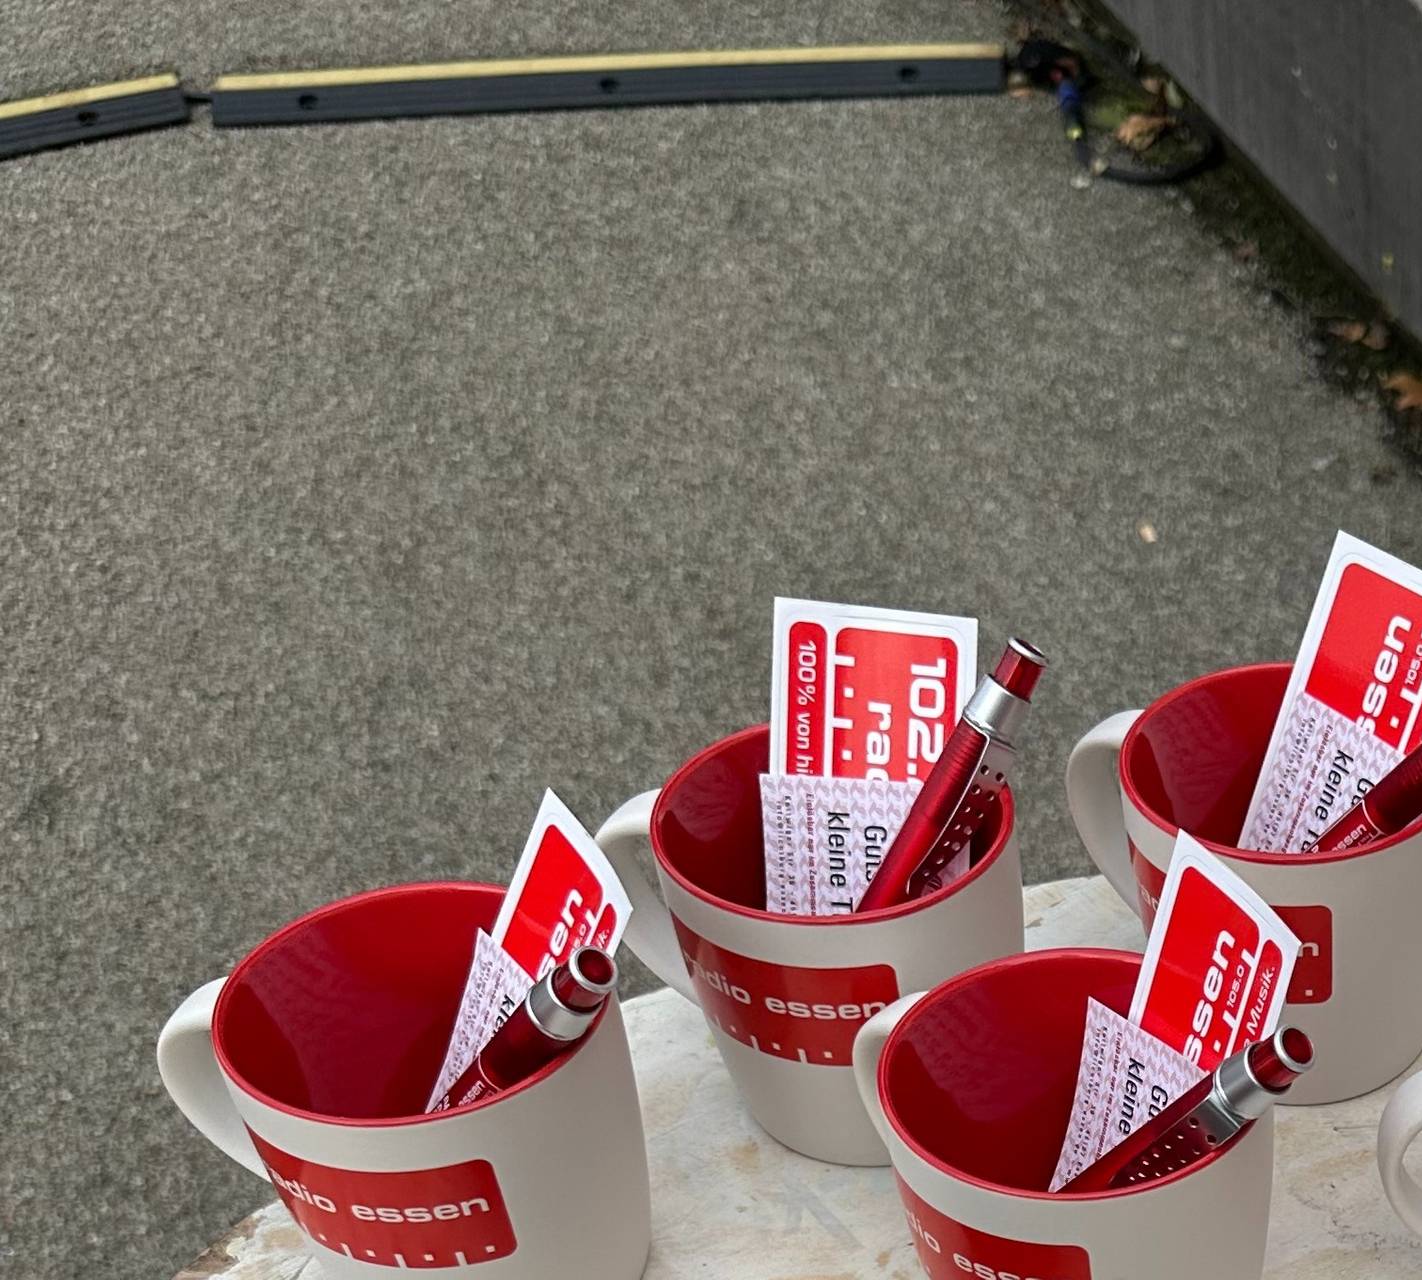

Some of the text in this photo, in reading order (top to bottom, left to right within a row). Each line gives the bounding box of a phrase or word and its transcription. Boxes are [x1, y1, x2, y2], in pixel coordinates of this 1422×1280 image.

[795, 640, 817, 777] 100% von hi
[906, 657, 947, 784] 102.
[1315, 749, 1354, 821] kleine
[827, 811, 854, 914] kleine T
[765, 996, 887, 1020] essen
[1226, 964, 1245, 1008] 105.0
[1246, 966, 1275, 1036] Musik.
[1118, 1056, 1145, 1135] kleine
[268, 1166, 491, 1223] adio essen
[953, 1253, 1043, 1280] ess
